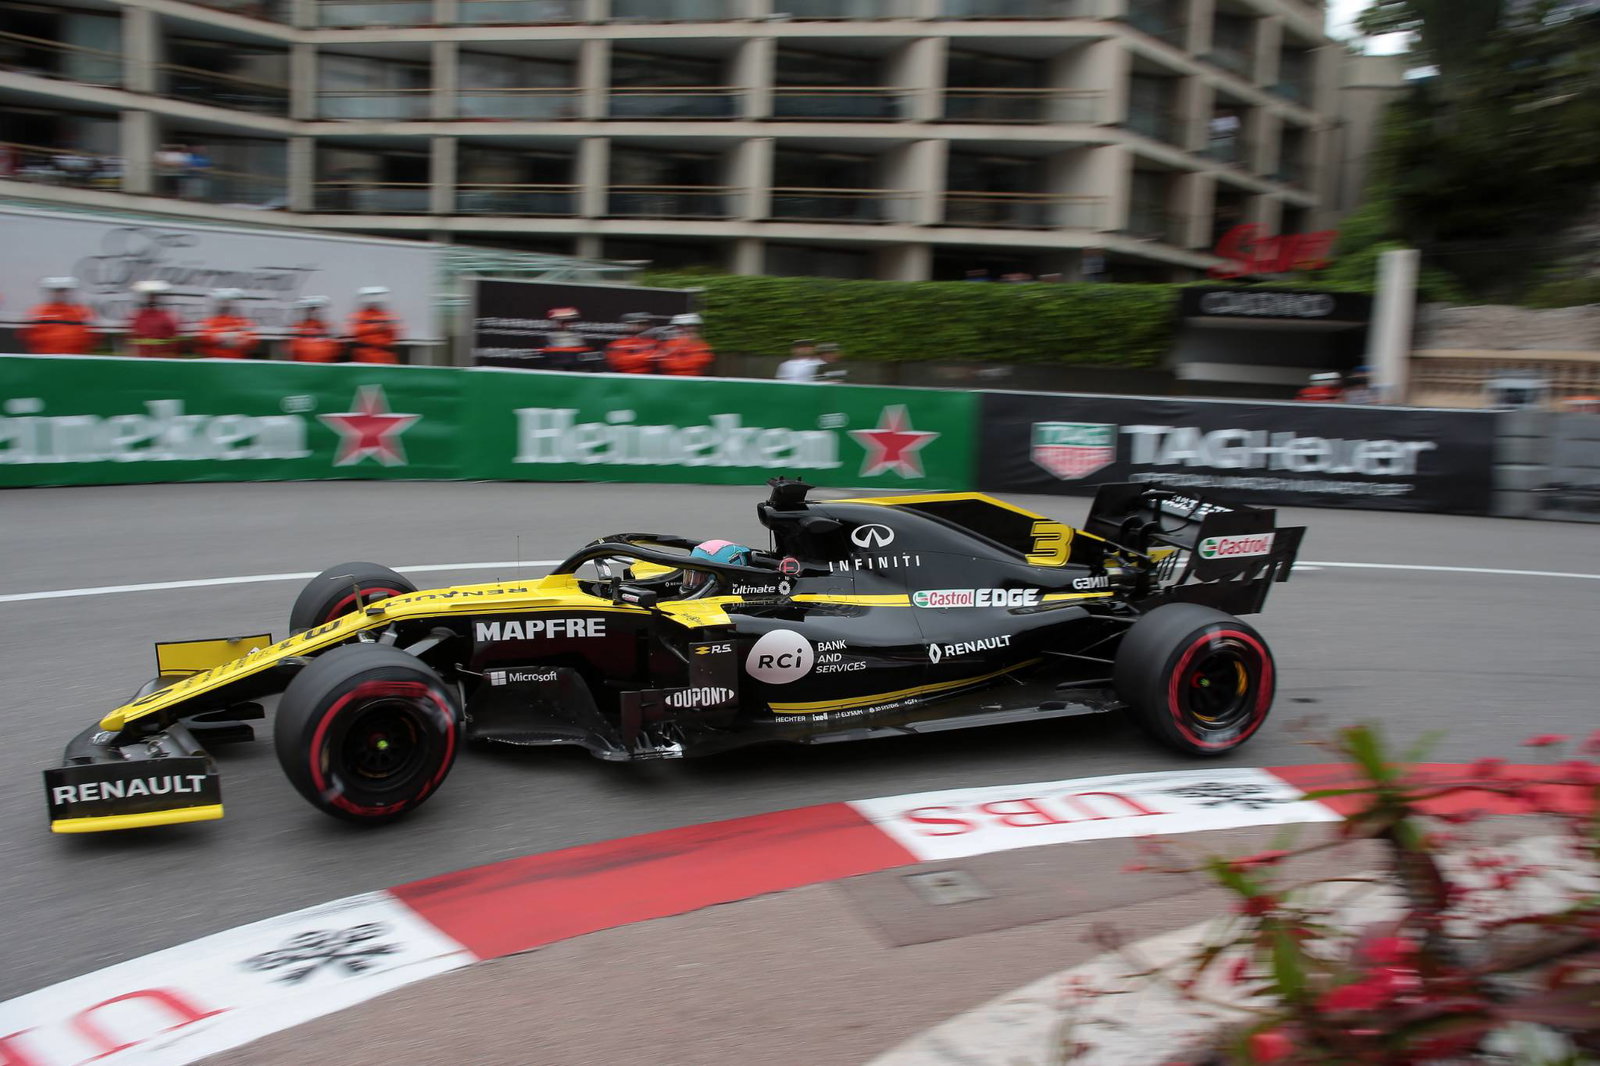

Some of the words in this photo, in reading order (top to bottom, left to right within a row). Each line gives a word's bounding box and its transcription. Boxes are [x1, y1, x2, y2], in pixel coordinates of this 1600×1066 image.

[0, 397, 313, 464] ineken
[513, 407, 843, 469] Heineken
[1025, 521, 1075, 567] 3
[1216, 537, 1271, 557] Castrol
[829, 555, 921, 573] INFINITI
[732, 585, 776, 595] ultimate
[930, 591, 972, 606] Castrol
[976, 588, 1040, 607] EDGE
[475, 618, 606, 642] MAPFRE
[818, 640, 847, 652] BANK
[944, 634, 1012, 657] RENAULT
[816, 661, 867, 674] SERVICES
[817, 653, 842, 664] AND
[509, 670, 557, 683] Microsoft
[673, 687, 727, 708] DUPONT
[775, 715, 806, 723] HECHTER
[53, 775, 207, 805] RENAULT
[903, 791, 1174, 837] UBS
